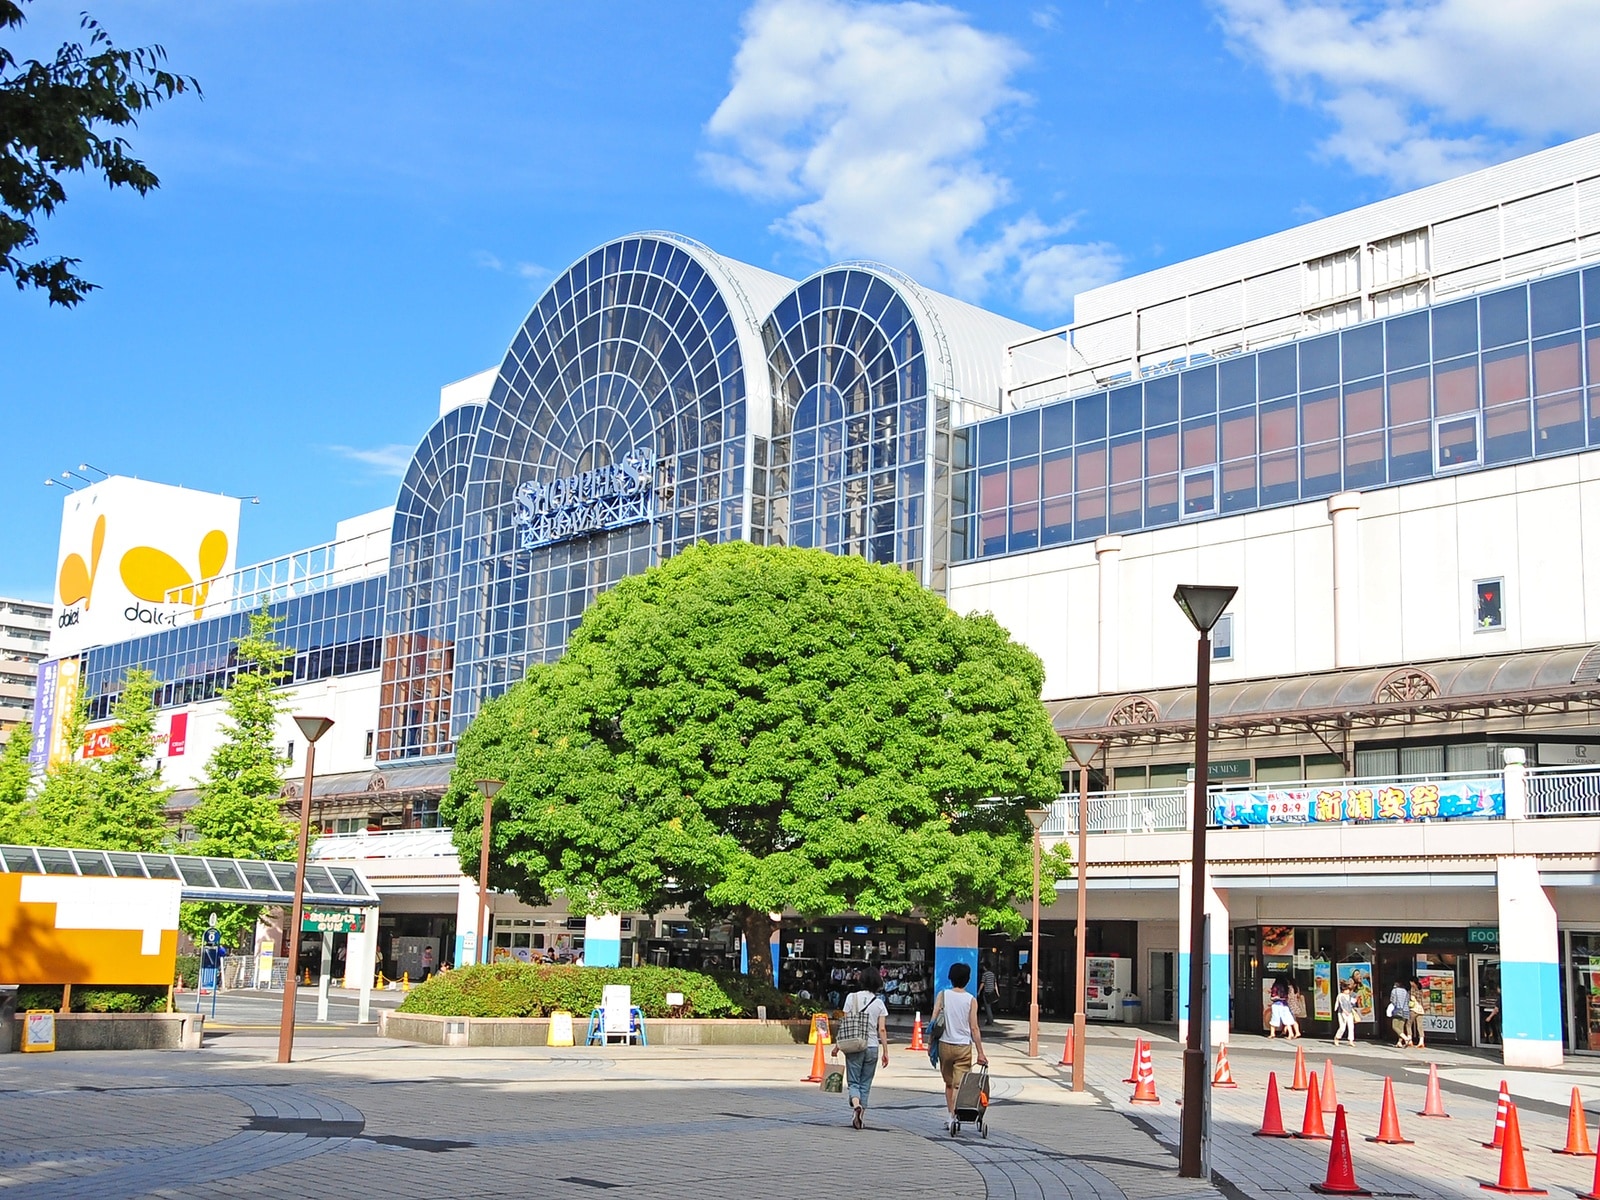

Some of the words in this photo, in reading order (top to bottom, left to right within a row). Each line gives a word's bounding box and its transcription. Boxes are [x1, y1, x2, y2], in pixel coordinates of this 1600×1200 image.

[1316, 784, 1439, 822] 新浦安祭
[317, 922, 343, 931] のりば
[1379, 931, 1428, 945] SUBWAY
[1430, 1019, 1454, 1030] ¥320
